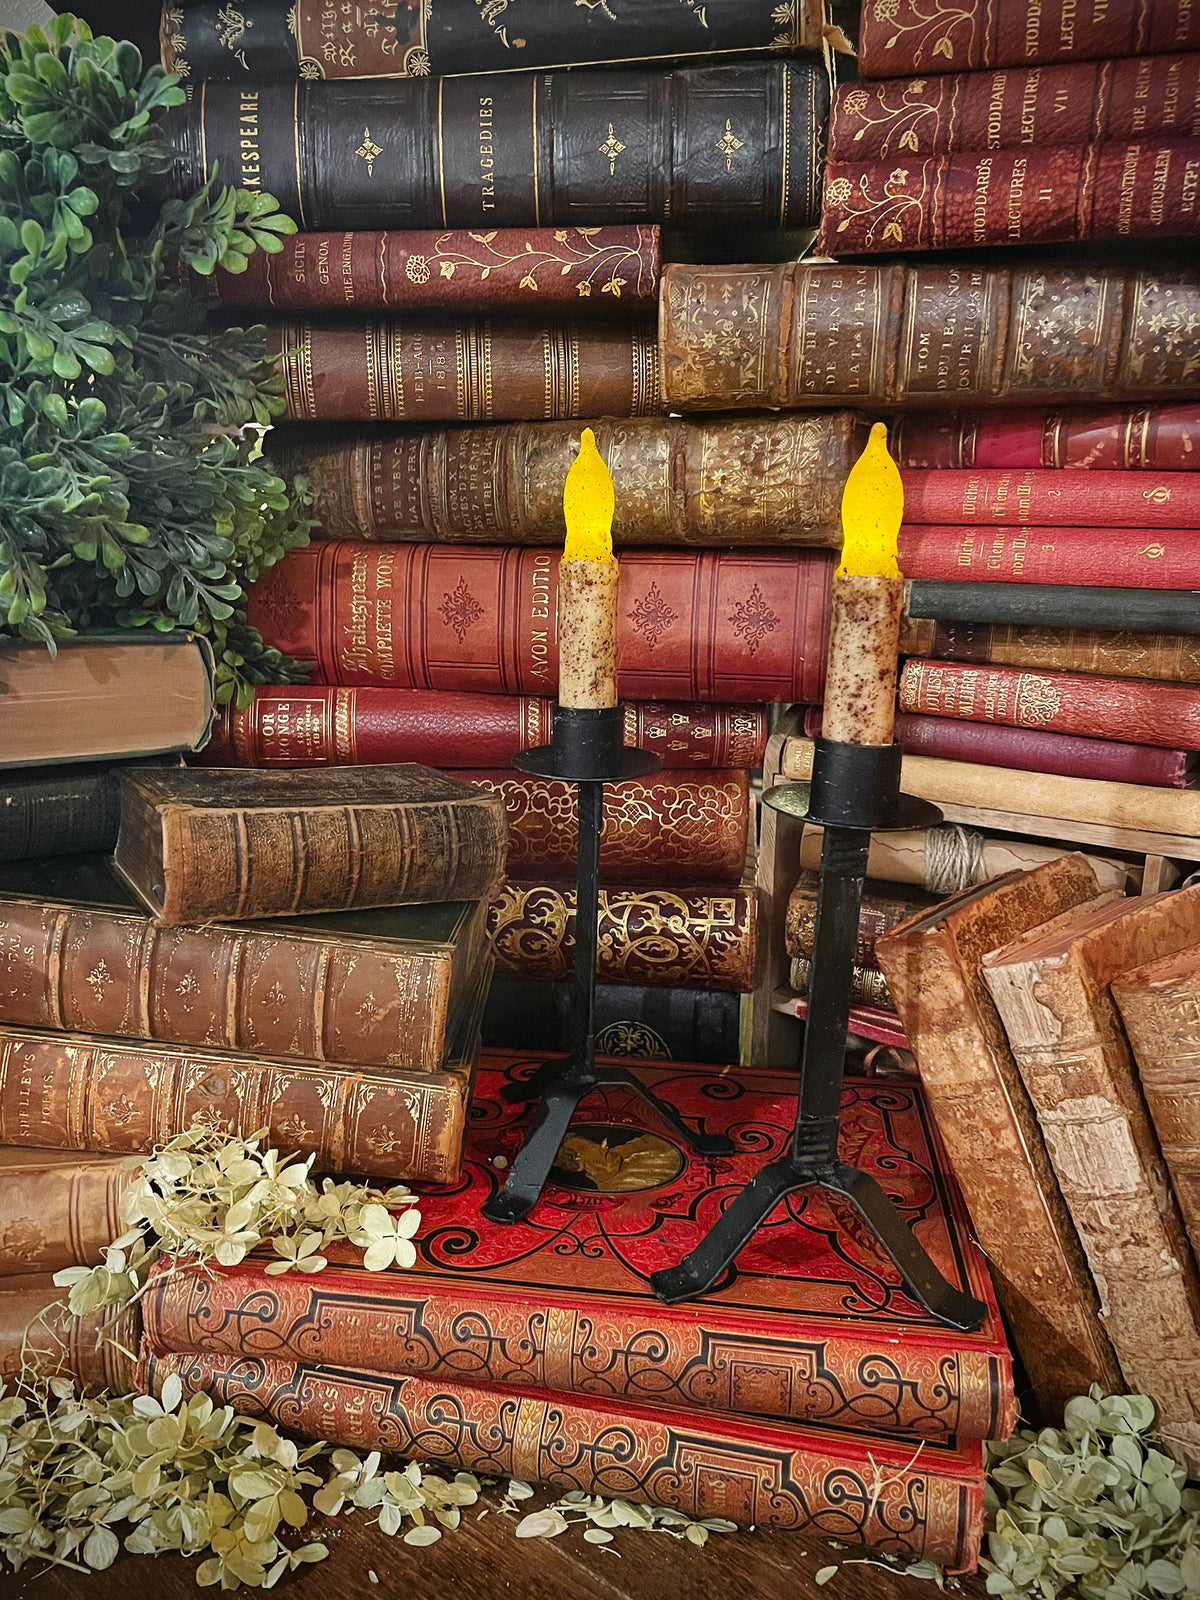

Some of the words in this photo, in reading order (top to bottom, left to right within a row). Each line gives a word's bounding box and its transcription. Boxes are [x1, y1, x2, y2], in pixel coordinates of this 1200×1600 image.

[1053, 89, 1069, 113] VII
[480, 96, 496, 211] TRAGEDIES
[973, 157, 993, 242] STODDARD'S
[1008, 158, 1028, 239] LECTURES
[1038, 187, 1053, 201] II
[1180, 160, 1199, 213] EGYPT
[294, 239, 306, 284] SICILY
[319, 239, 330, 286] GENOA
[806, 278, 820, 349] BIBLE
[828, 279, 842, 348] VENCE
[826, 360, 836, 385] DE
[917, 331, 930, 373] TOM
[450, 488, 460, 522] TOM
[1041, 544, 1055, 552] 3
[531, 555, 550, 619] EDITIO
[376, 599, 396, 681] COMPLETE
[926, 669, 943, 711] LOUISE
[997, 679, 1010, 716] DUMAS
[312, 717, 320, 745] 1940
[18, 1053, 36, 1137] SHELLEY'S
